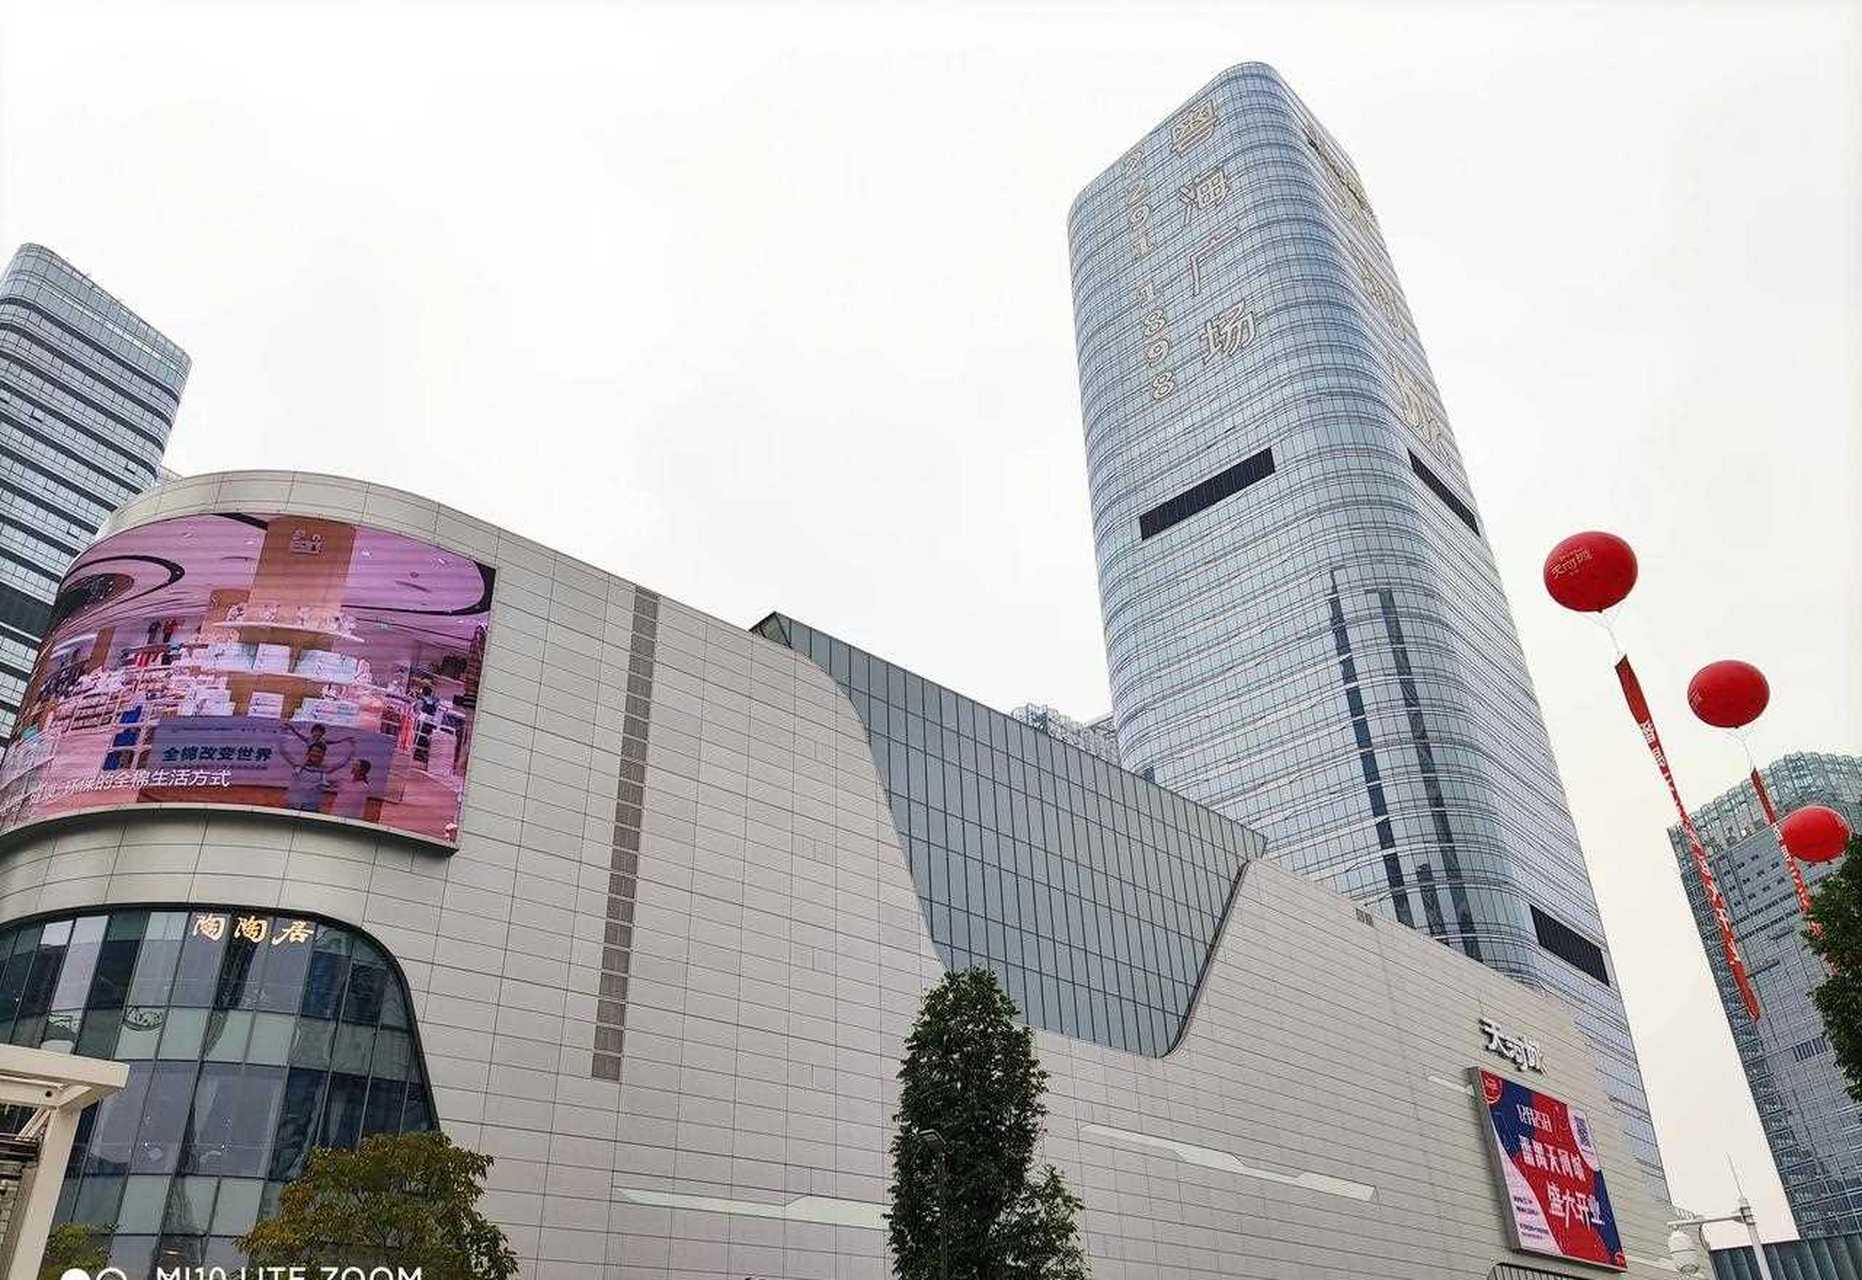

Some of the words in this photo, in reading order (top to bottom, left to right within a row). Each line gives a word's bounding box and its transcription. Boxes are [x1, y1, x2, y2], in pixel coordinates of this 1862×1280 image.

[192, 912, 315, 946] 陶陶居
[1546, 1183, 1605, 1229] 盛大开业
